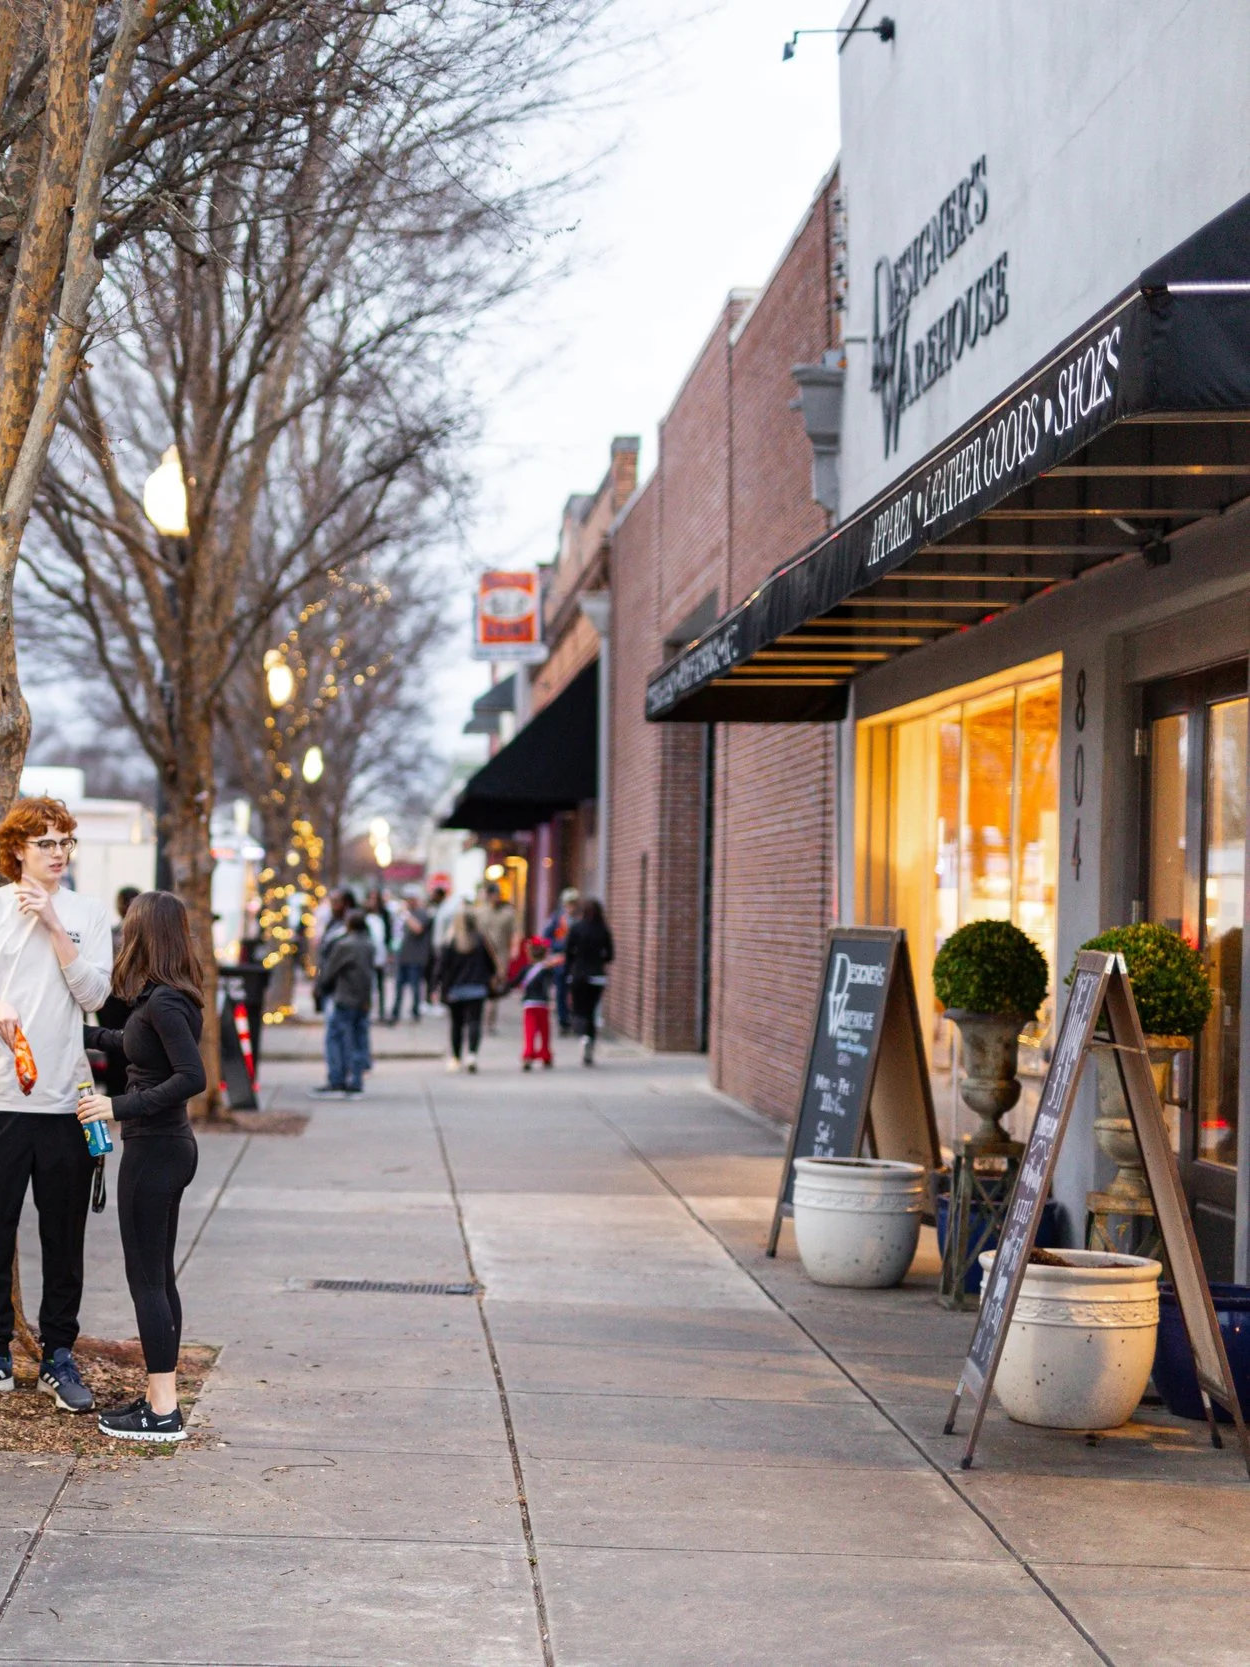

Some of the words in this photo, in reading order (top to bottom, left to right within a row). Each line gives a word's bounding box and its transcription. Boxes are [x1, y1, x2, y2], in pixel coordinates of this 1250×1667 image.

[870, 154, 989, 378] DESIGNER'S
[871, 251, 1009, 461] WAREHOUSE
[868, 490, 912, 566] APPAREL
[922, 437, 981, 528] LEATHER
[984, 393, 1039, 486] GOODS
[1054, 326, 1121, 436] SHOES
